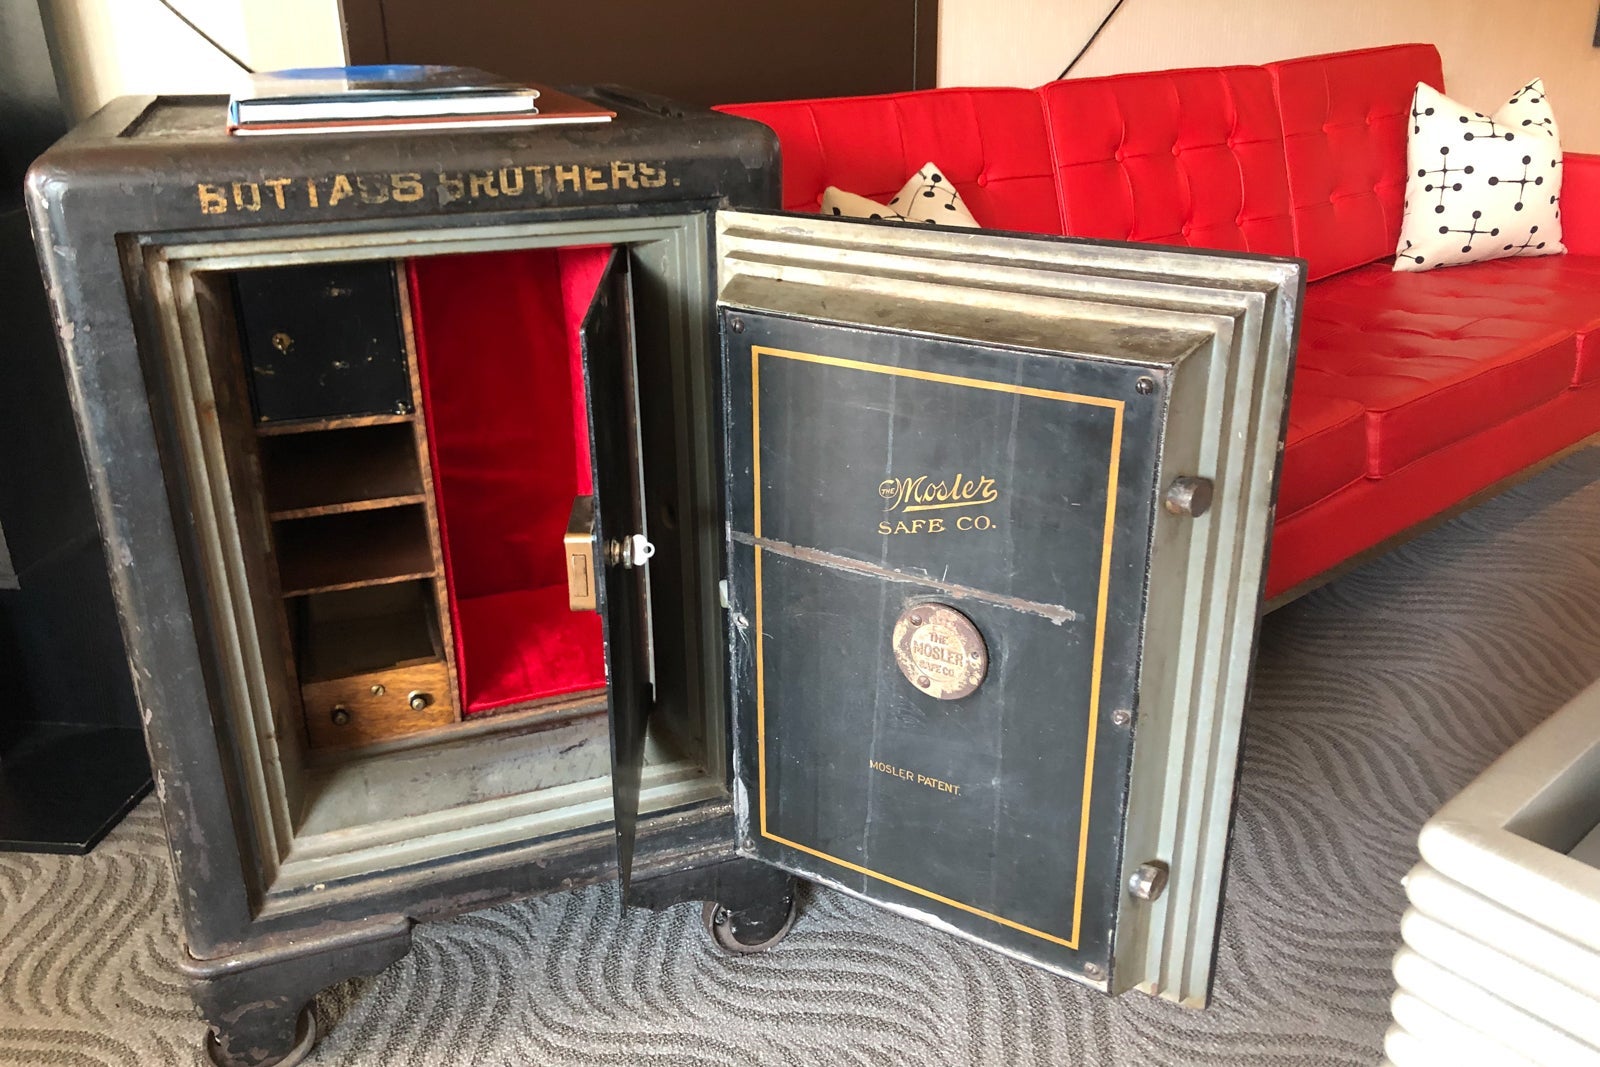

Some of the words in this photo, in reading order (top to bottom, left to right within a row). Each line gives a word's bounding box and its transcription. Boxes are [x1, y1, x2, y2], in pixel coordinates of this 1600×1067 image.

[888, 473, 998, 512] Mosler
[878, 518, 946, 535] SAFE
[956, 515, 997, 531] CO.
[929, 631, 948, 645] THE
[913, 639, 963, 668] MOSLER
[869, 759, 914, 782] MOSLER
[917, 773, 962, 797] PATENT.
